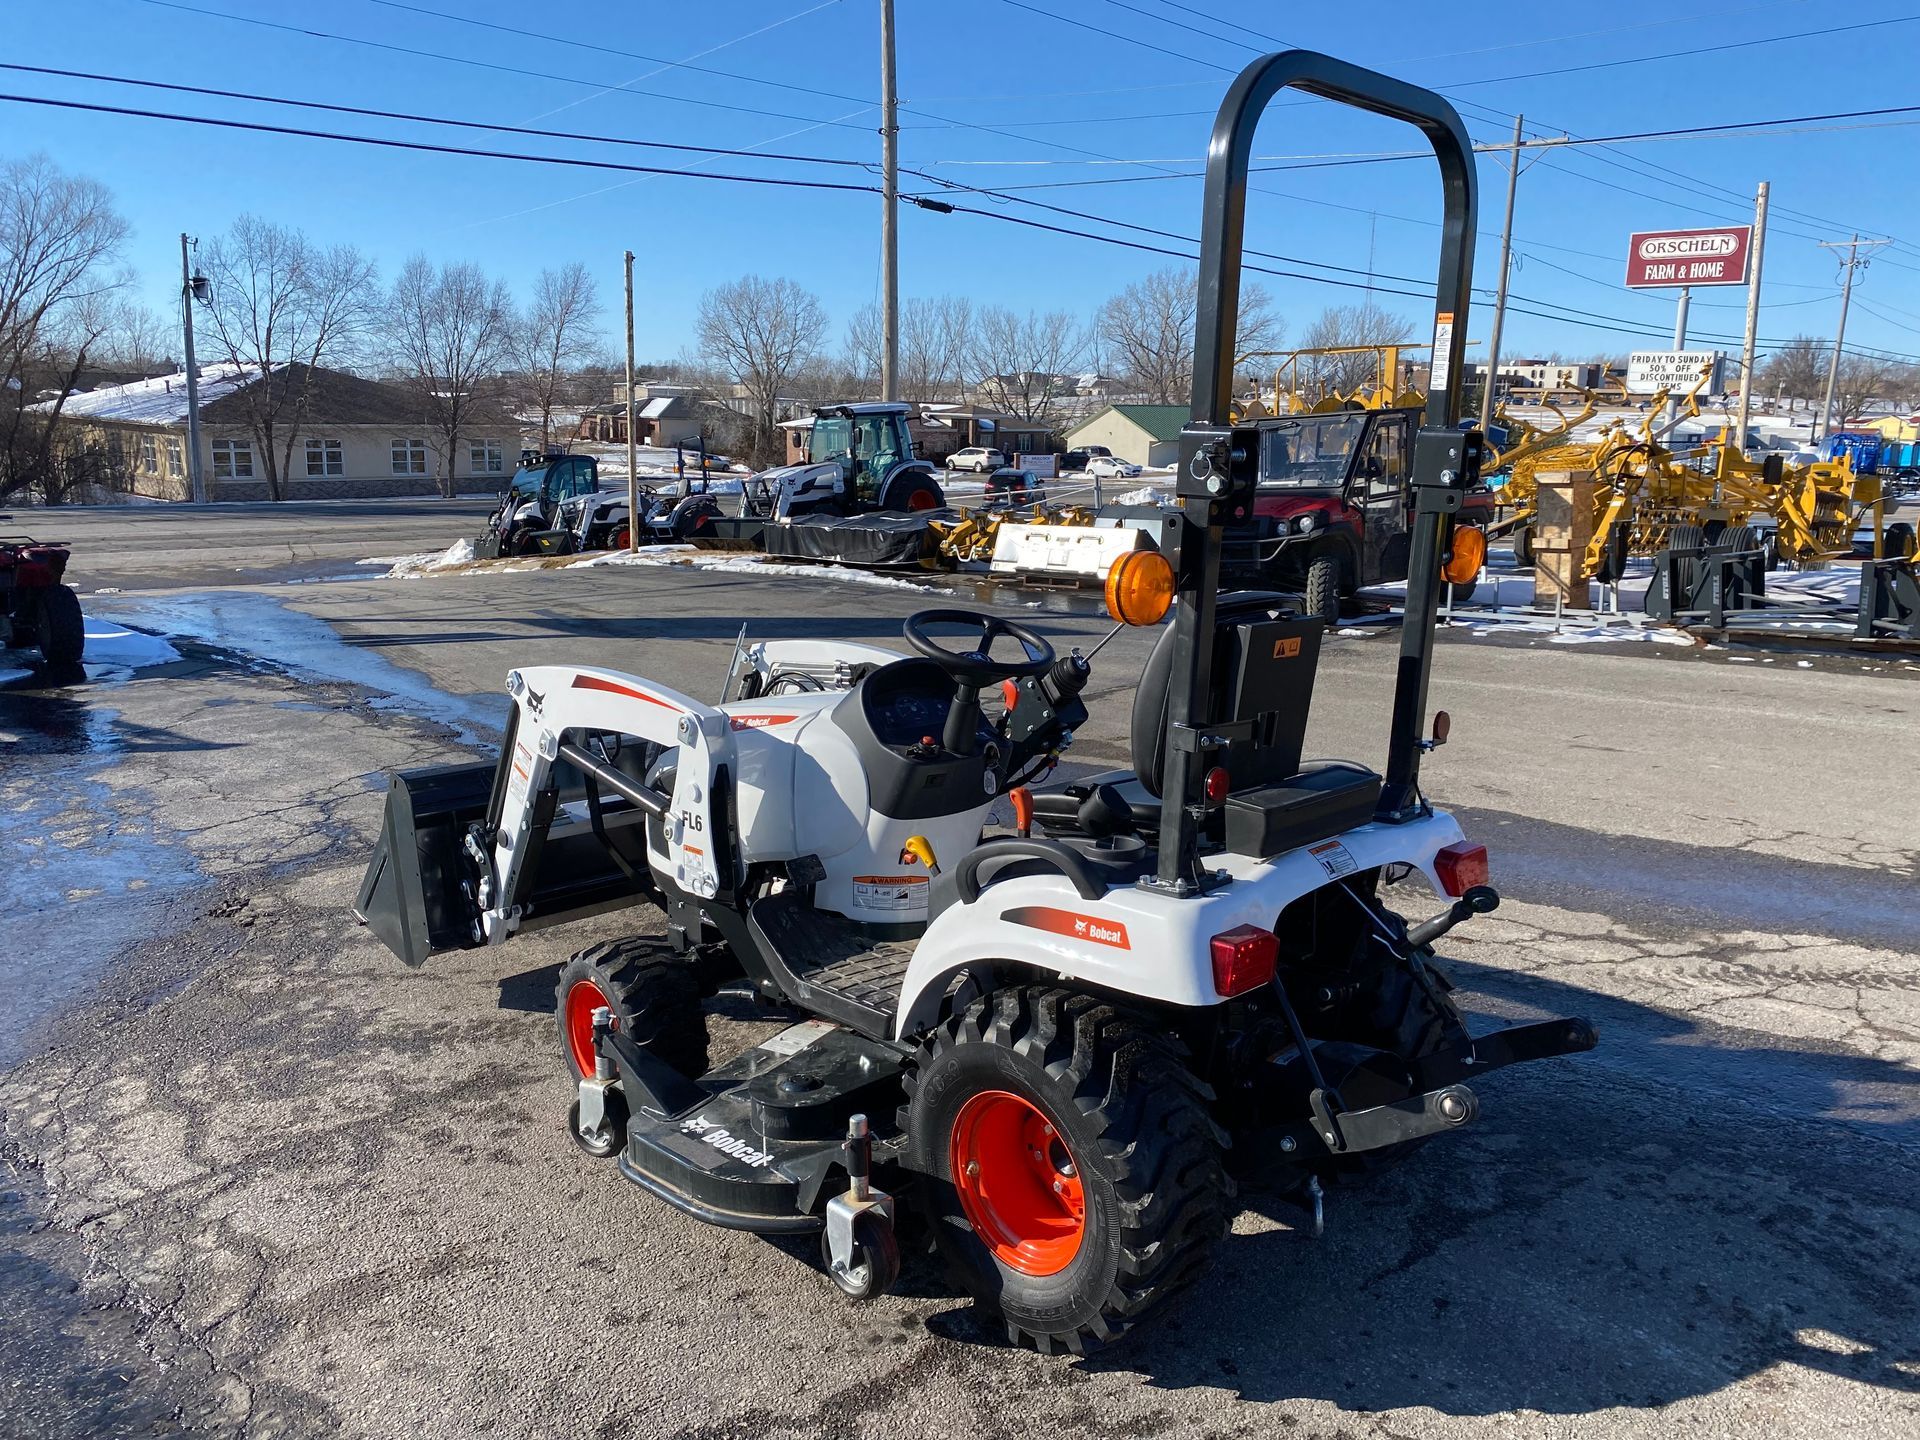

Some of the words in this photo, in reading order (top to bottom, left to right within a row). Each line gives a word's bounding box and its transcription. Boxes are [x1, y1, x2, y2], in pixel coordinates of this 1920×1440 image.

[1645, 238, 1730, 254] ORSCHELN
[1644, 263, 1676, 280] FARM
[1678, 265, 1687, 279] &
[1689, 261, 1724, 278] HOME
[1631, 355, 1663, 364] FRIDAY
[1665, 355, 1676, 364] TO
[1677, 355, 1712, 364] SUNDAY
[1649, 364, 1667, 372] 50%
[1675, 364, 1691, 373] OFF
[1640, 373, 1700, 382] DISCONTINUED
[746, 718, 770, 727] Bobcat
[682, 810, 703, 832] FL6
[1089, 924, 1121, 943] Bobcat
[701, 1129, 775, 1168] Bobcat
